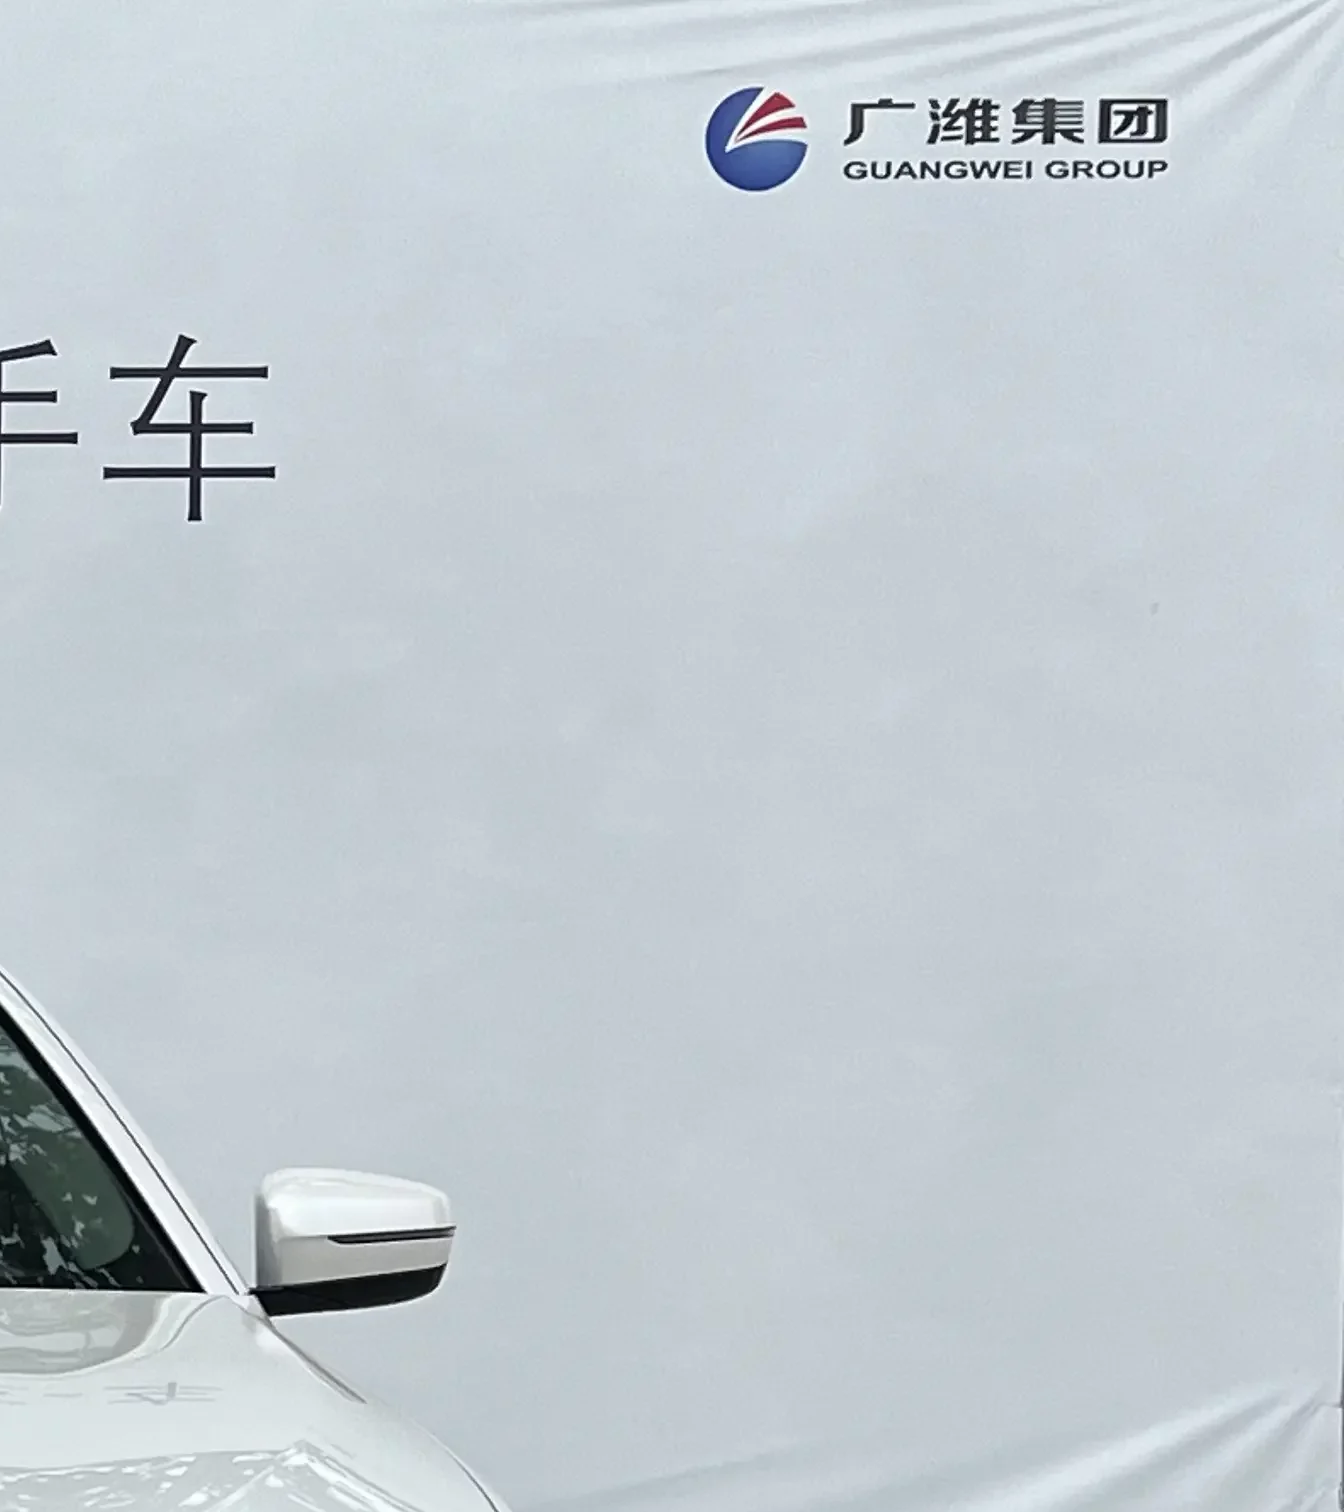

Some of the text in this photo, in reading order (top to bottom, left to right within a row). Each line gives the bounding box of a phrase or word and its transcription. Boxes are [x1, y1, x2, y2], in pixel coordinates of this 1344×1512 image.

[843, 98, 1169, 146] 广潍集团
[843, 159, 1169, 180] GUANGWEI GROUP
